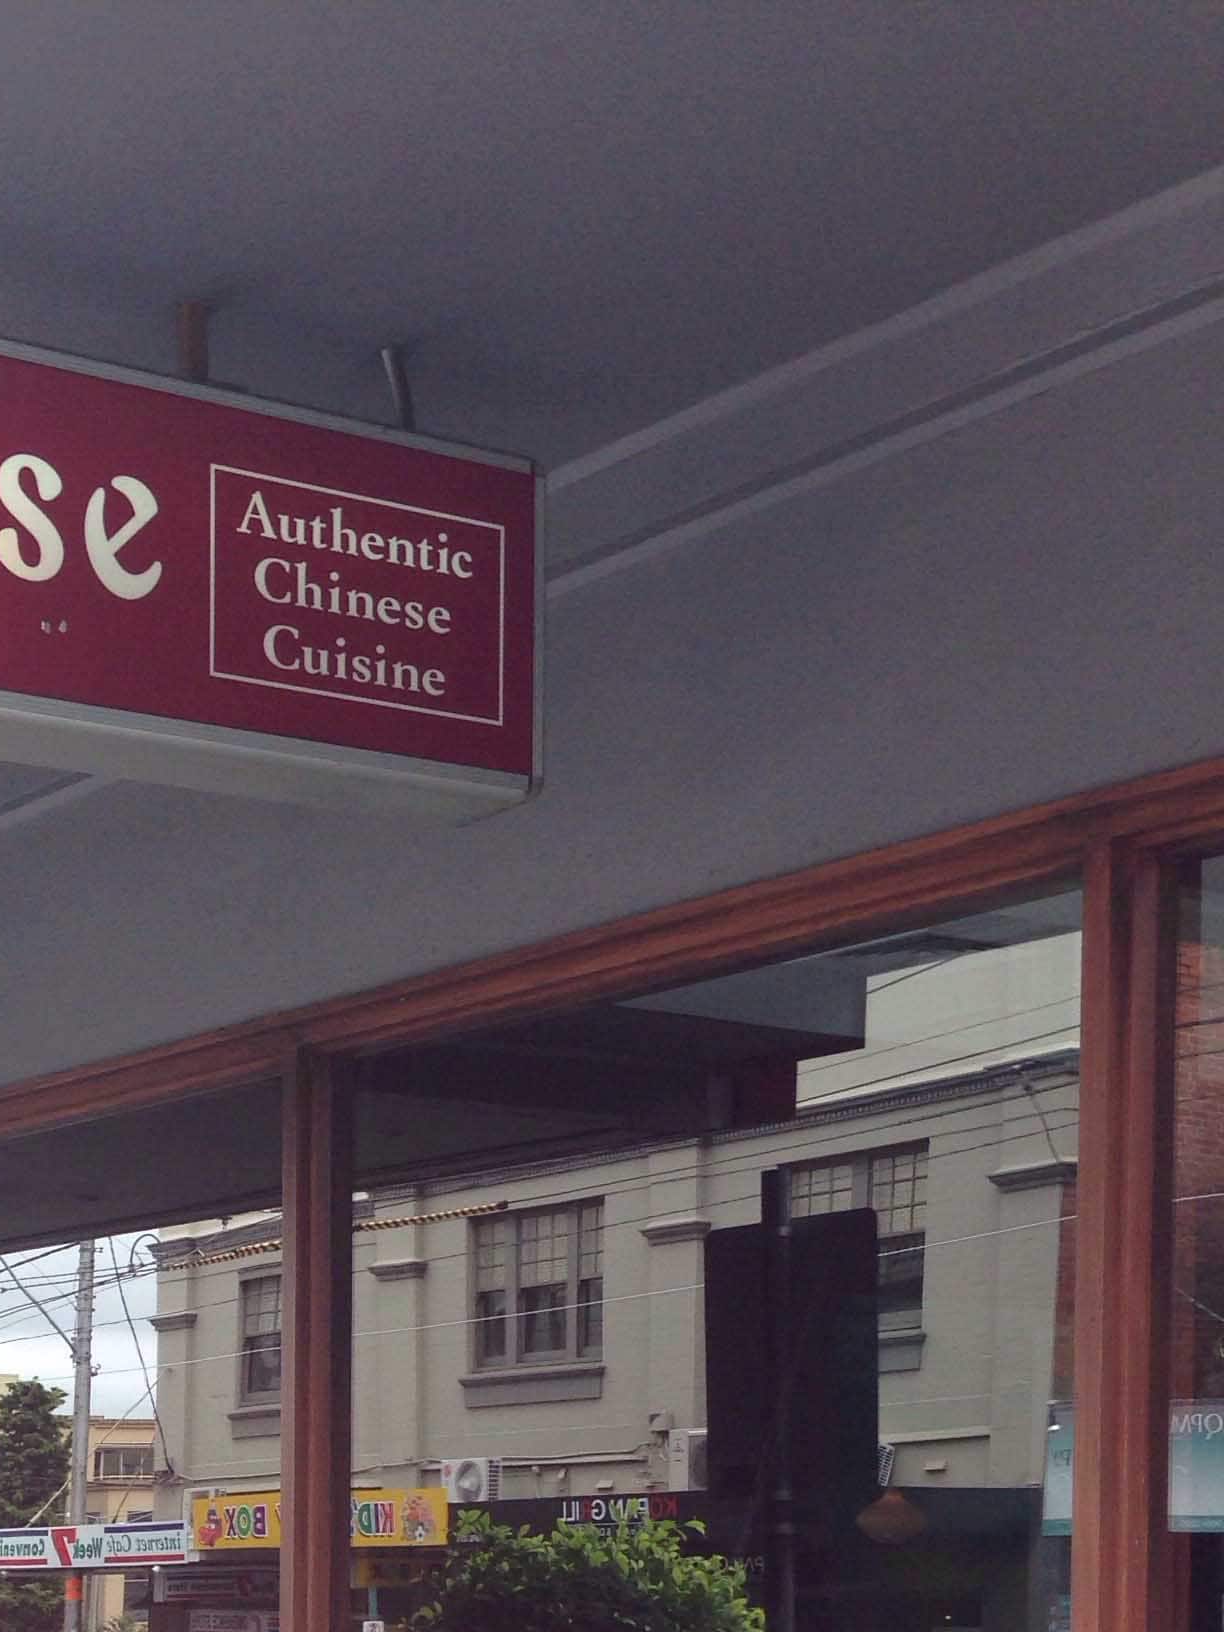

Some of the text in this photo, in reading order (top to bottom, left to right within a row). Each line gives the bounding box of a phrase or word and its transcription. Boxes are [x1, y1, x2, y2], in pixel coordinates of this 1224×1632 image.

[236, 490, 473, 579] Authentic
[253, 557, 451, 635] Chinese
[262, 624, 446, 697] Cuisine
